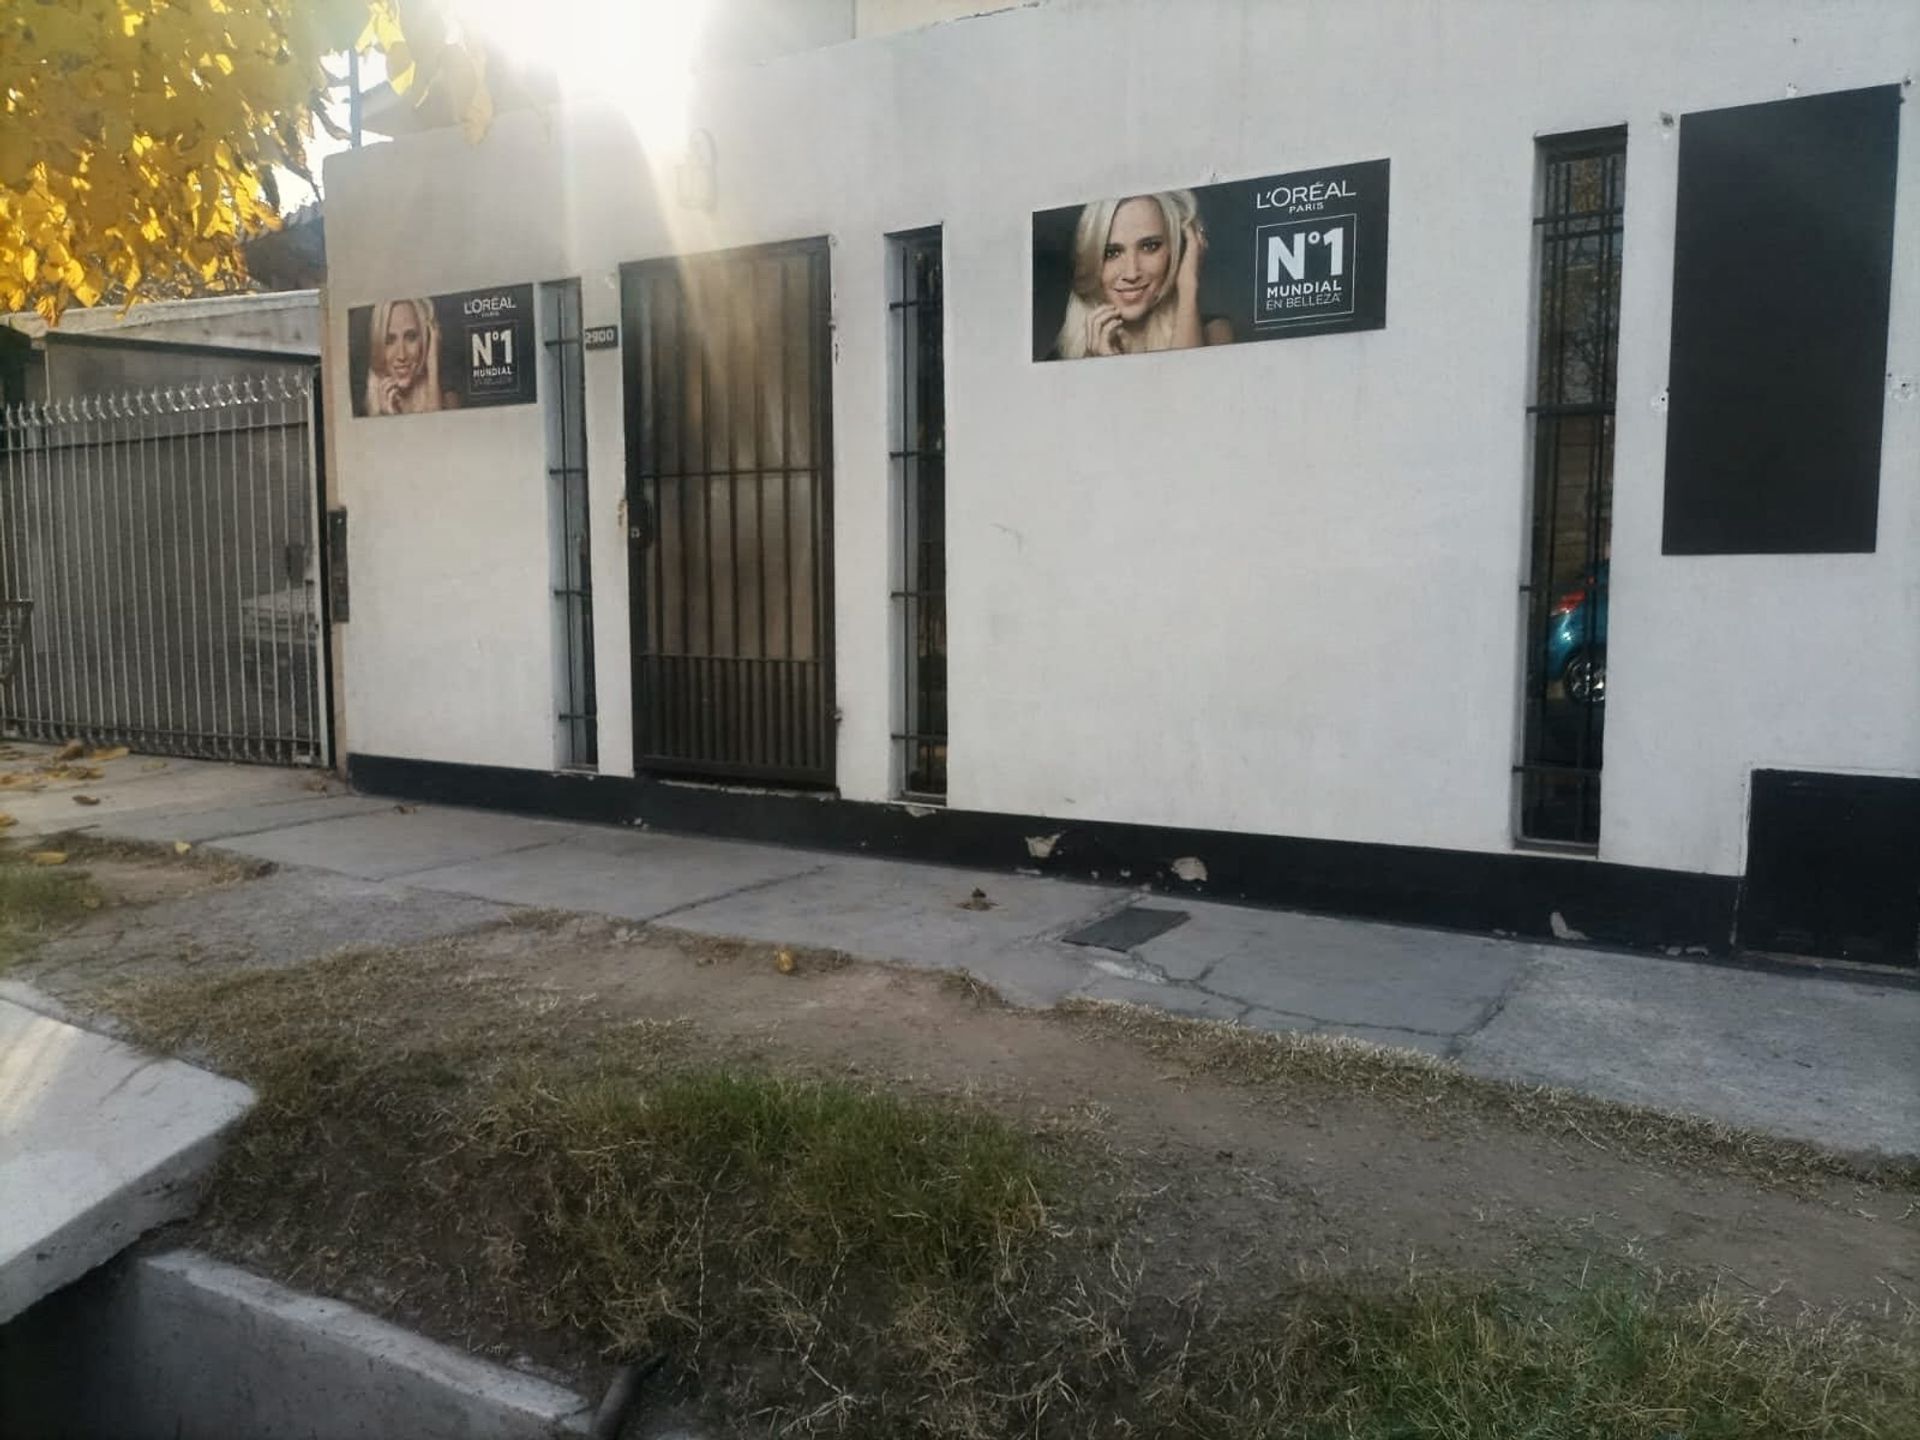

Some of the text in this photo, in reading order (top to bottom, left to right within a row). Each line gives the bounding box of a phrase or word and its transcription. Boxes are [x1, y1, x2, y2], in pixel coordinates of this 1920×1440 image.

[1256, 180, 1357, 209] L'ORÉAL
[1288, 202, 1325, 214] PARIS
[1267, 280, 1342, 299] MUNDIAL
[1266, 292, 1341, 311] EN BELLEZA
[585, 328, 614, 343] 2900
[472, 365, 512, 378] MUNDIAL
